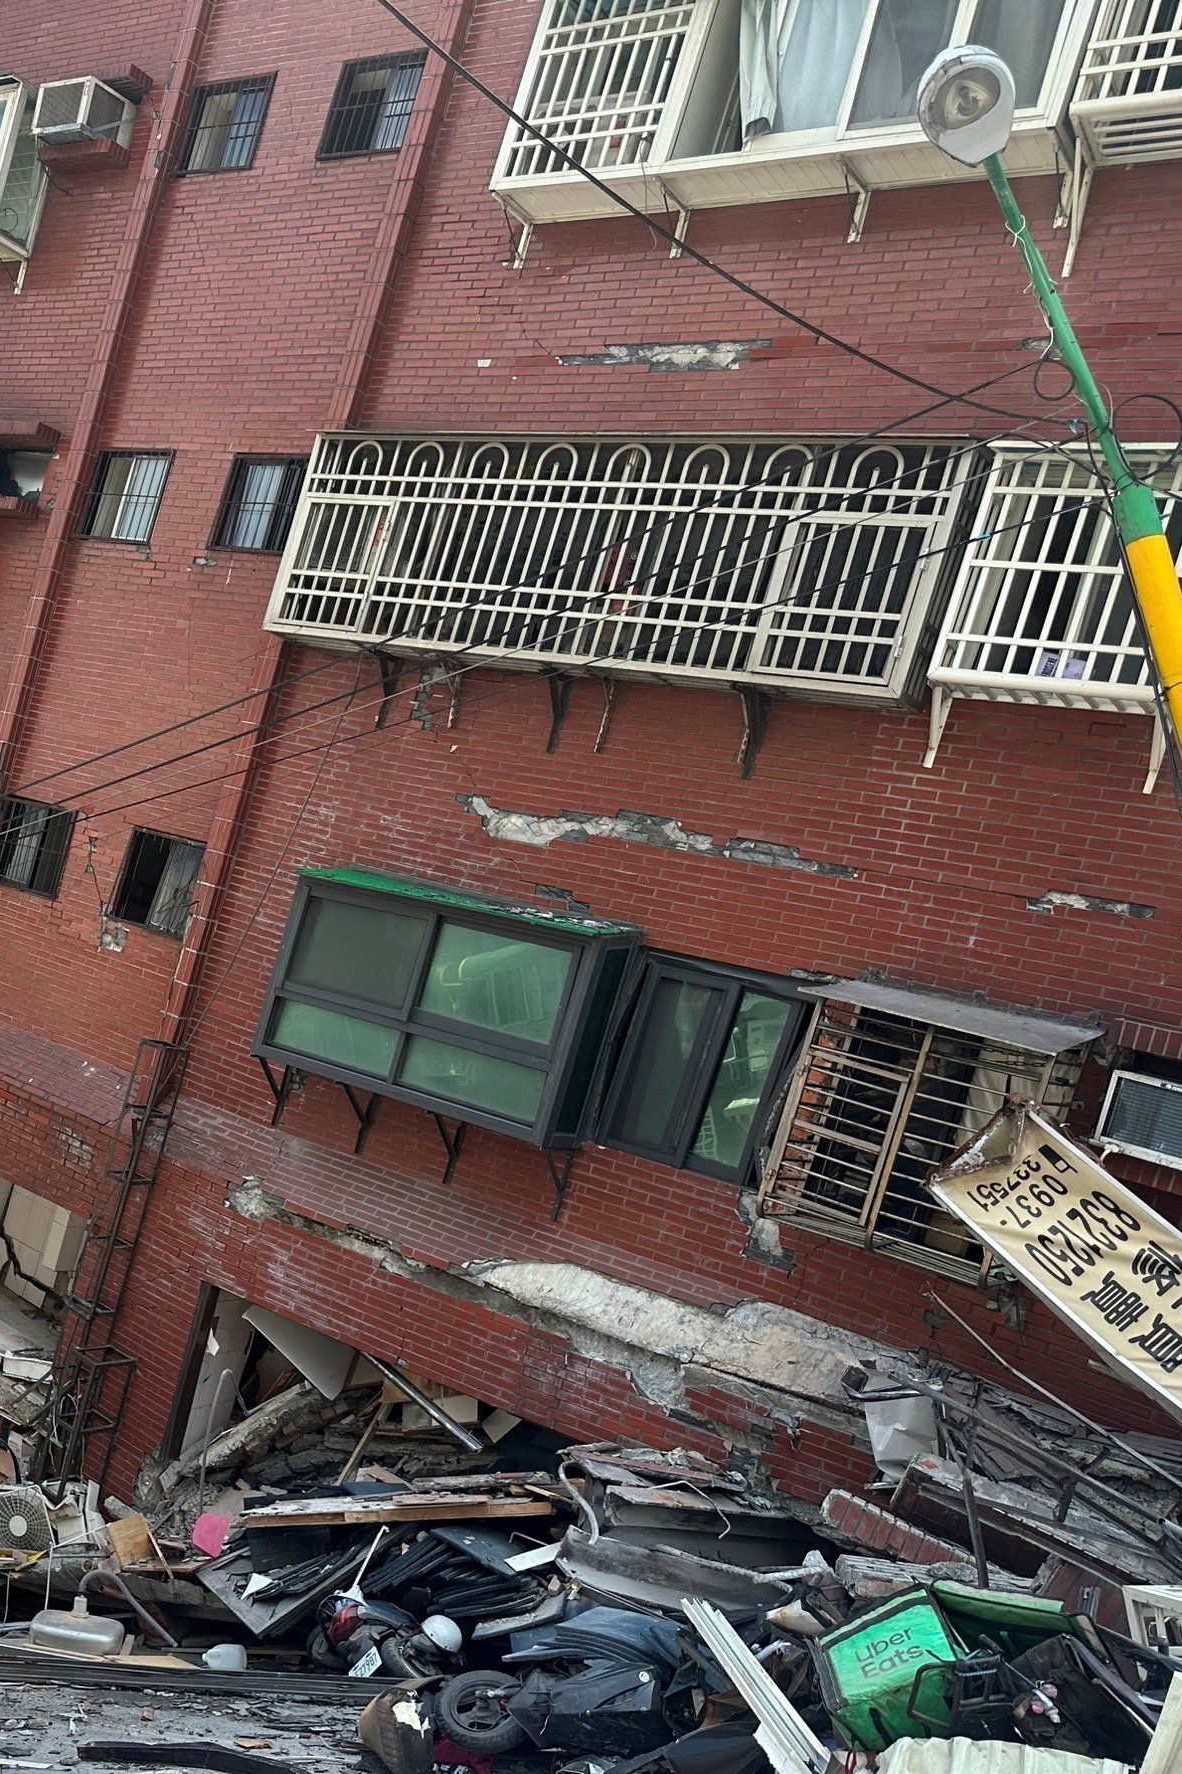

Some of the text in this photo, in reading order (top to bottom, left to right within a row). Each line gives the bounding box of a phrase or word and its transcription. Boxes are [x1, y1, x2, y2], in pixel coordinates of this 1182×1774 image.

[1025, 1190, 1141, 1286] 8321250
[855, 1627, 912, 1662] Uber
[860, 1645, 924, 1679] Eats
